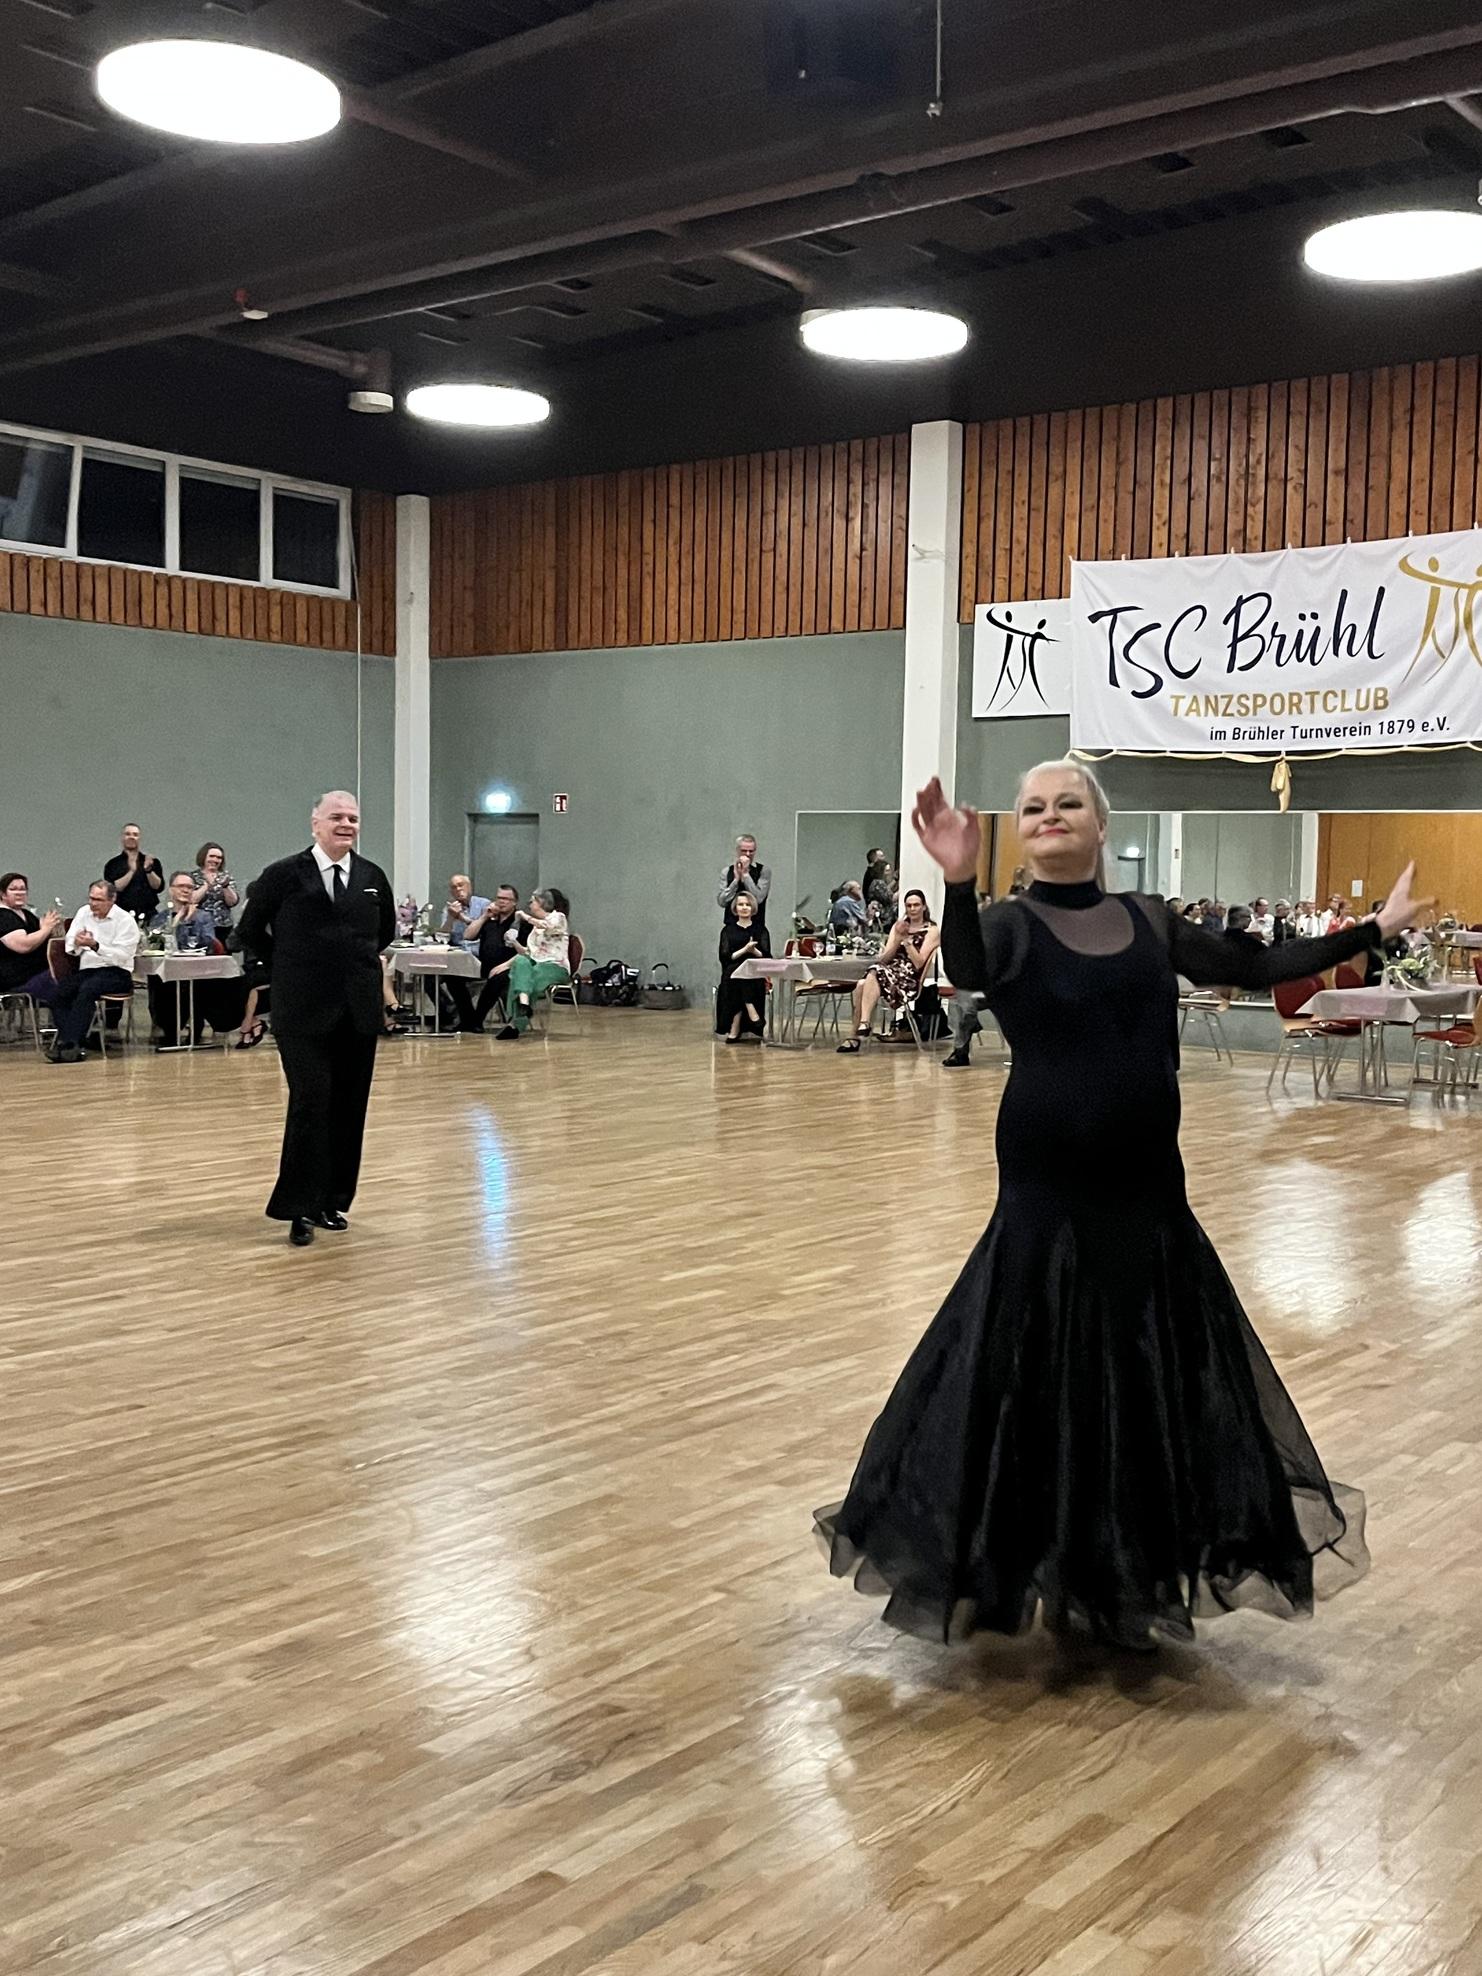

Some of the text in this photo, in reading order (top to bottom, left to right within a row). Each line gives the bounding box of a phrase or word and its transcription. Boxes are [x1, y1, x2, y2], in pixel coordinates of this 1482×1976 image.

[1088, 586, 1386, 699] TSC Brühl
[1170, 687, 1390, 718] TANZSPORTCLUB
[1209, 716, 1451, 742] im Brühler Turnverein 1879 e.V.
